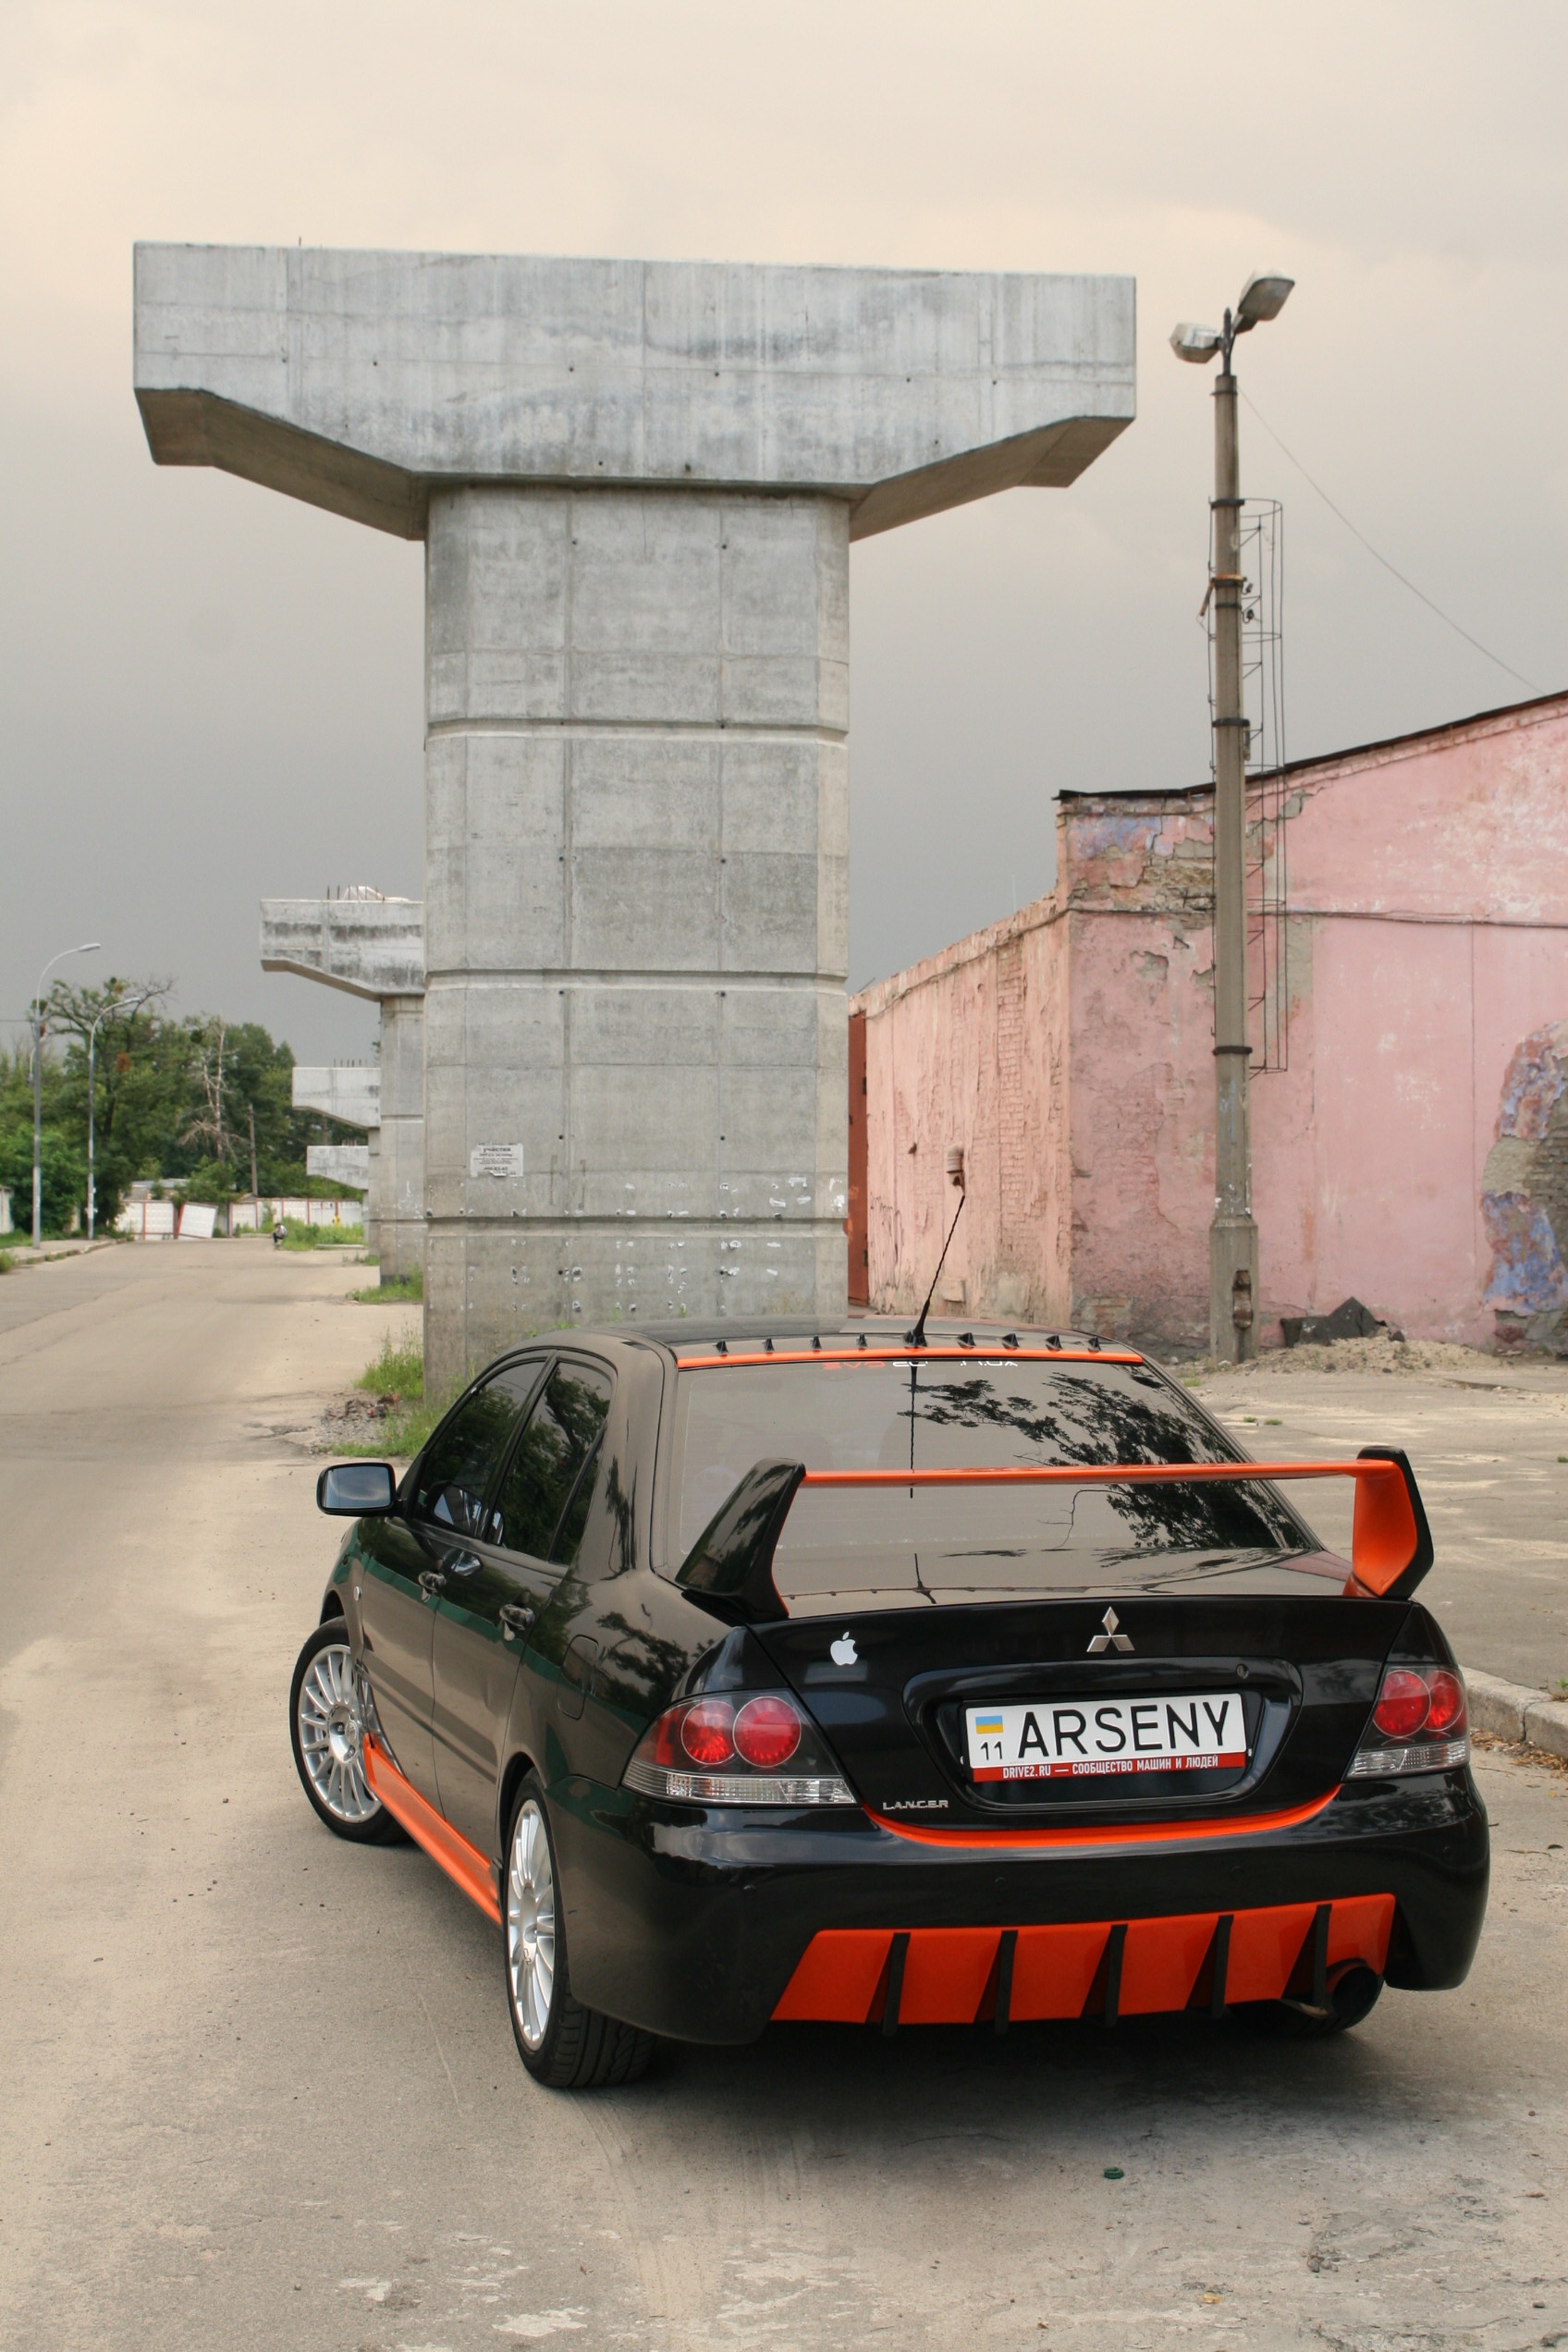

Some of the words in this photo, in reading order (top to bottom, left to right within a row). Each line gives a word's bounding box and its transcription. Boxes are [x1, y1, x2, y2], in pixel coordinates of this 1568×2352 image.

[1017, 1700, 1230, 1758] ARSENY
[980, 1740, 1003, 1760] 11
[1002, 1765, 1051, 1779] DRIVE2.RU
[1072, 1759, 1133, 1775] СООБЩЕСТВО
[1136, 1757, 1172, 1771] МАШИН
[1175, 1757, 1182, 1769] И
[1185, 1754, 1219, 1769] ЛЮДЕЙ
[882, 1799, 949, 1811] LANCER
